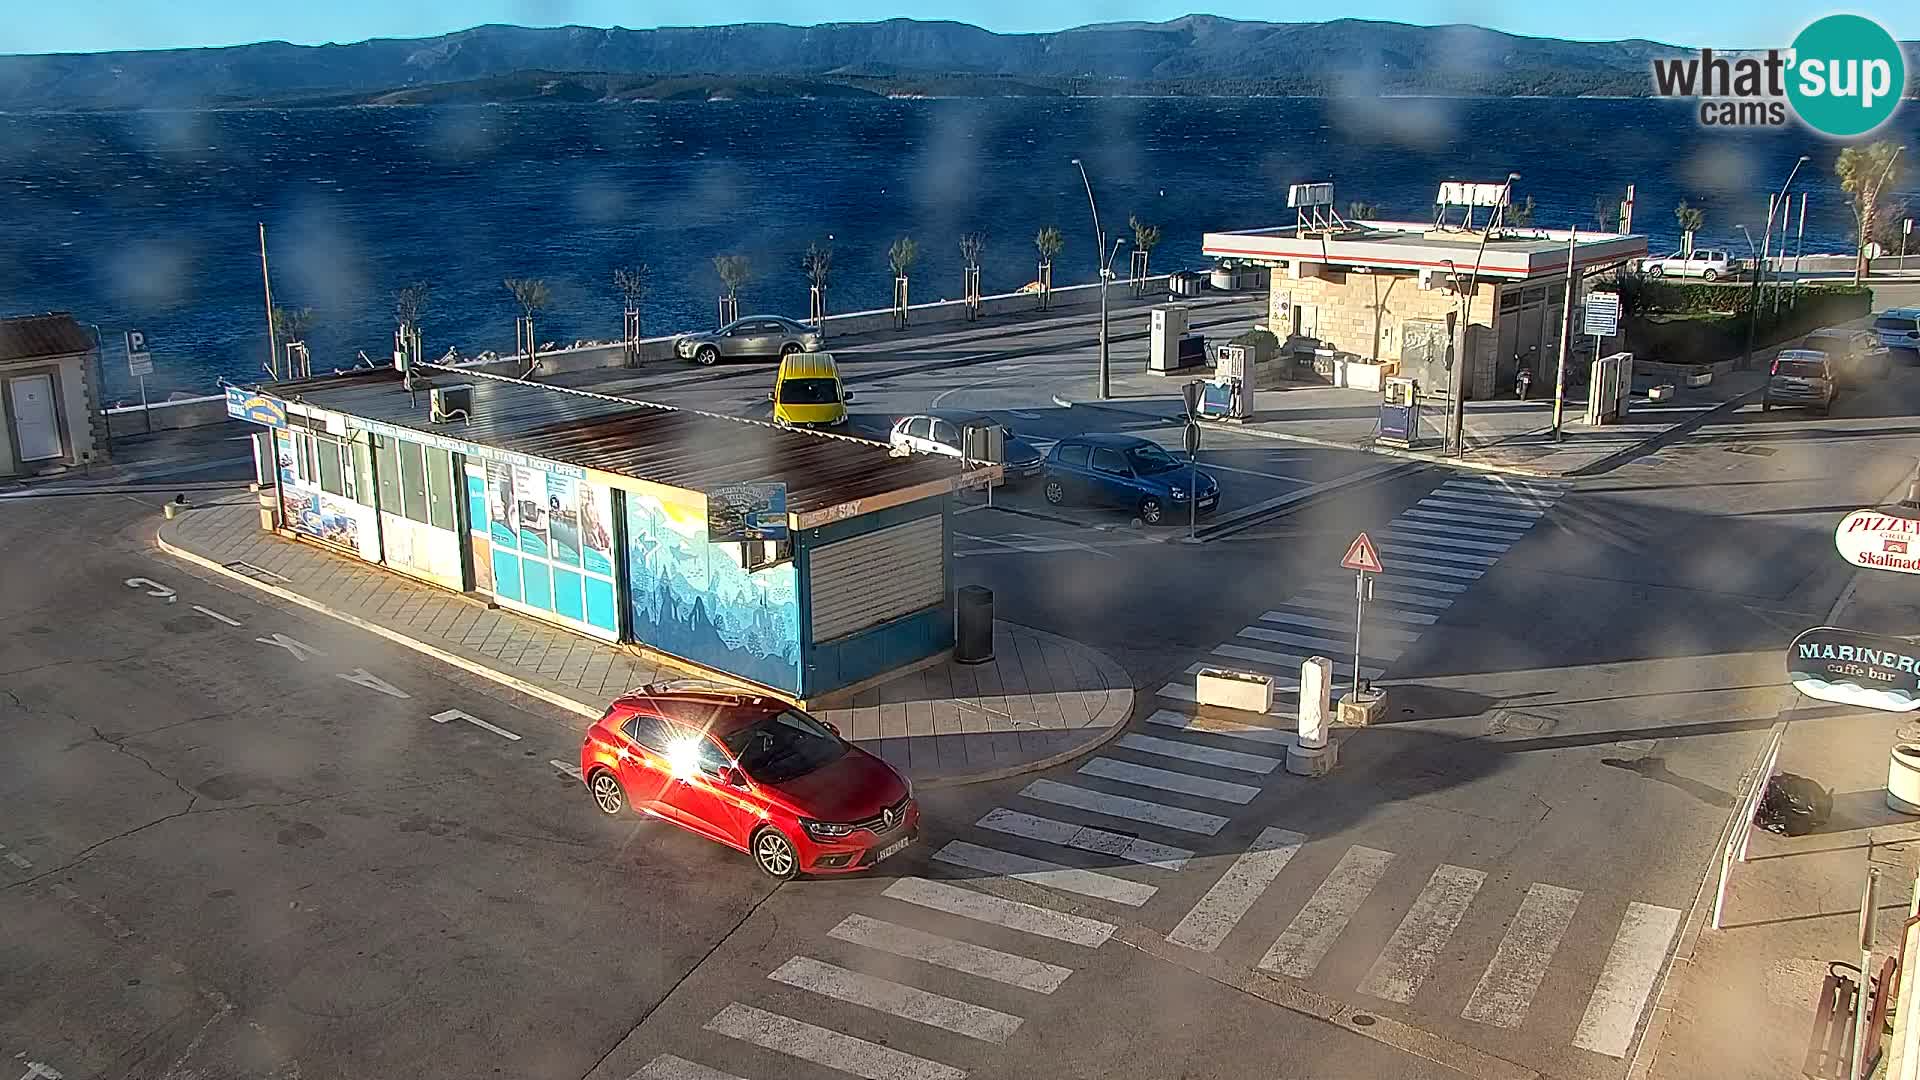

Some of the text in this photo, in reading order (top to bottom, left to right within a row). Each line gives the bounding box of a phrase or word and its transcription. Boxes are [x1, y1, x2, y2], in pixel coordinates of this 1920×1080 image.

[131, 332, 144, 351] P
[494, 448, 527, 467] STATION
[528, 456, 556, 473] TICKET
[556, 462, 584, 479] OFFICE
[1868, 666, 1897, 682] bar
